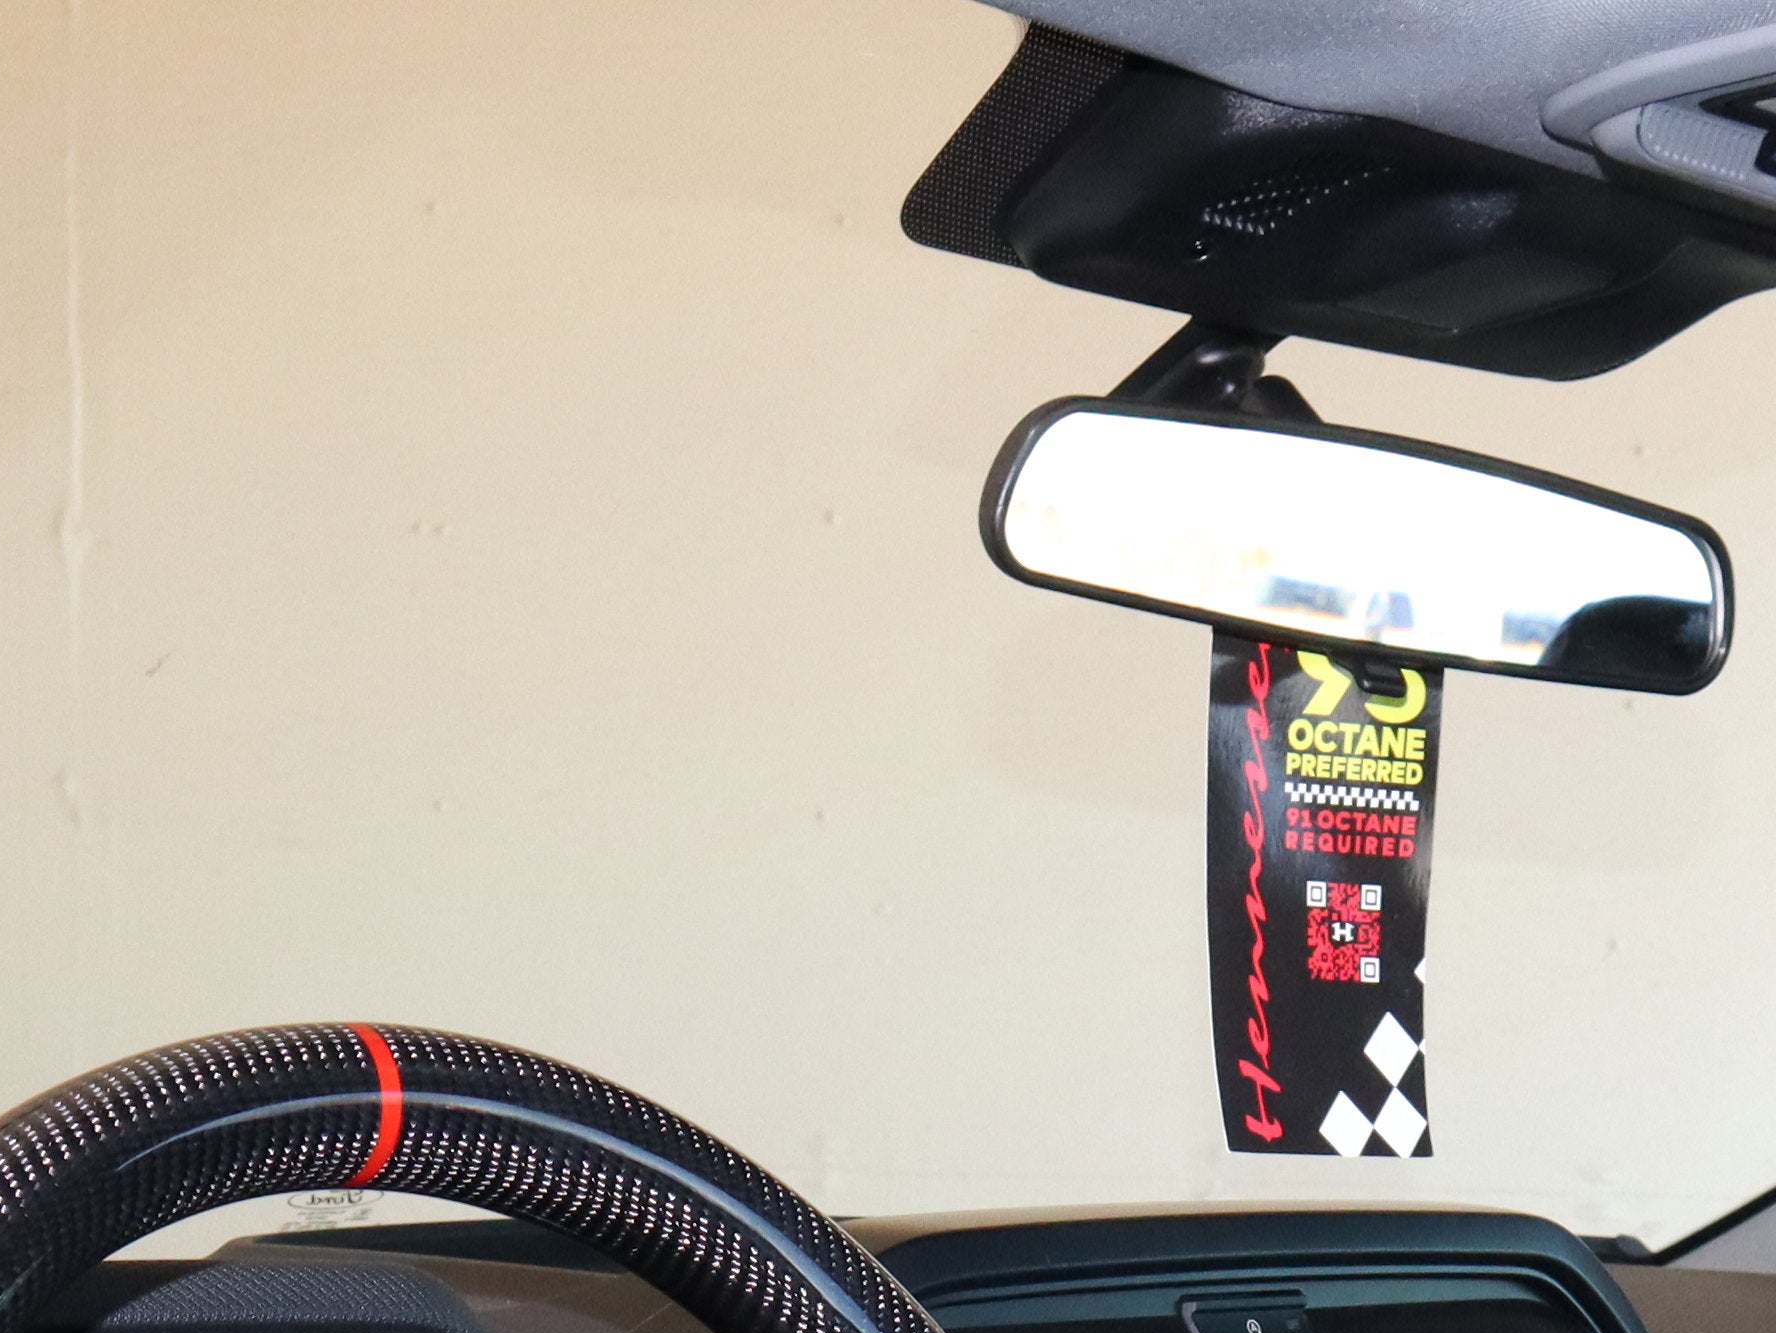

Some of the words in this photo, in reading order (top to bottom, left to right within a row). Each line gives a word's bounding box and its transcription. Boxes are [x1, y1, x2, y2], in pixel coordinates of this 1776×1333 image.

[1287, 718, 1427, 760] OCTANE
[1284, 751, 1424, 786] PREFERRED
[1284, 806, 1314, 828] 91
[1315, 809, 1418, 836] OCTANE
[1283, 829, 1417, 859] REQUIRED
[1238, 642, 1285, 1142] Hennesse
